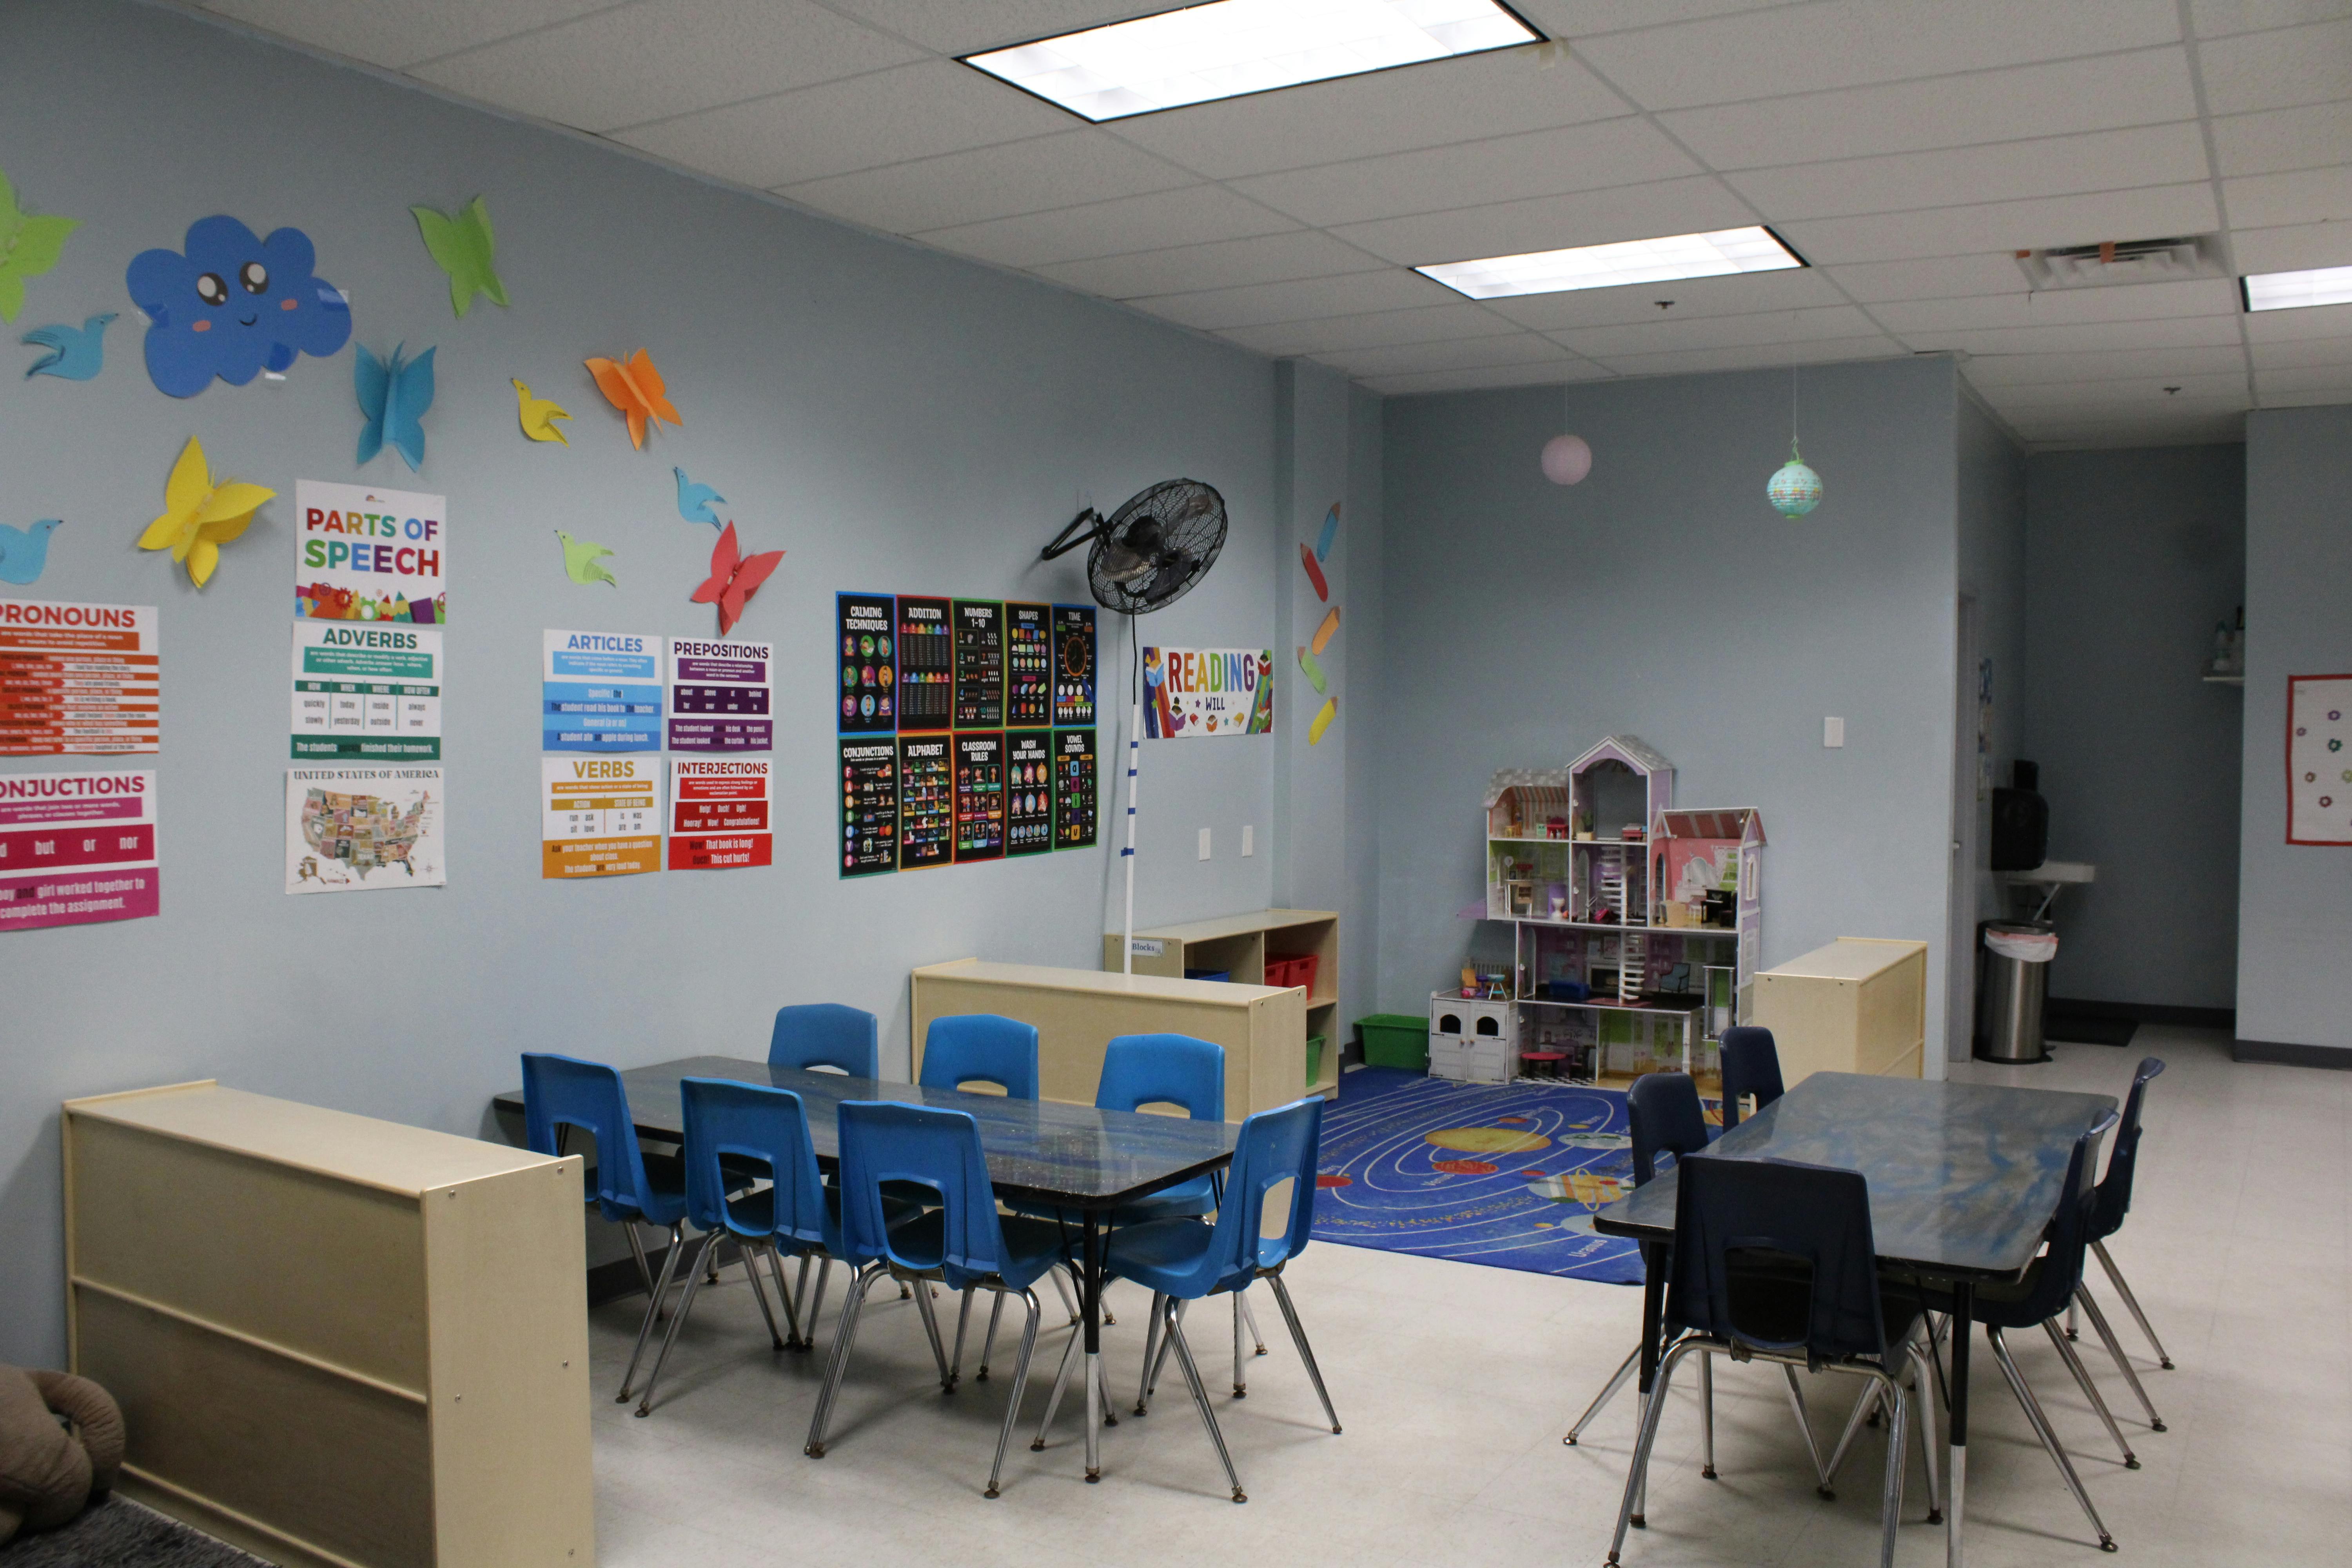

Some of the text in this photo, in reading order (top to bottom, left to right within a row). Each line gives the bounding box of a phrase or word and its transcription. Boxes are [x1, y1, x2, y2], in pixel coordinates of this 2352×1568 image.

[307, 508, 437, 541] PARTS OF
[304, 539, 439, 576] SPEECH
[0, 604, 135, 628] RONOUNS
[850, 606, 882, 618] CALMING
[908, 607, 942, 619] ADDITION
[964, 607, 992, 618] NUMBERS
[1019, 610, 1038, 621] SHAPES
[1068, 612, 1081, 621] TIME
[846, 619, 887, 631] TECHNIQUES
[972, 619, 985, 628] 1-10
[323, 628, 417, 649] ADVERBS
[568, 635, 642, 652] ARTICLES
[674, 642, 768, 659] PREPOSITIONS
[1168, 652, 1255, 692] READING
[304, 700, 325, 708] quickly
[340, 701, 354, 709] today
[408, 703, 425, 711] always
[1206, 697, 1225, 711] WILL
[305, 717, 323, 725] slowly
[334, 717, 360, 726] yesterday
[1021, 740, 1036, 749] WASH
[1067, 735, 1082, 744] VOWEL
[908, 744, 943, 757] ALPHABET
[962, 741, 996, 751] CLASSROOM
[1065, 744, 1084, 753] SOUNDS
[844, 746, 893, 758] CONJUNCTIONS
[971, 752, 988, 761] RULES
[1013, 750, 1045, 760] YOUR HANDS
[573, 761, 634, 778] VERBS
[678, 762, 768, 774] INTERJECTIONS
[846, 768, 851, 777] F
[294, 771, 334, 779] UNITED
[337, 771, 376, 779] STATES
[847, 782, 851, 792] A
[1075, 795, 1077, 806] i
[35, 840, 55, 855] but
[83, 839, 96, 851] or
[120, 837, 138, 849] nor
[706, 839, 718, 849] That
[719, 839, 733, 849] book
[733, 838, 739, 848] is
[739, 838, 753, 849] long!
[847, 841, 851, 851] Y
[711, 854, 722, 864] This
[723, 854, 733, 863] cut
[733, 853, 750, 862] hurts!
[847, 855, 852, 866] S
[37, 884, 55, 898] girl
[56, 882, 93, 895] worked
[94, 879, 133, 893] together
[135, 878, 145, 889] to
[0, 897, 125, 918] complete the assignment.
[1568, 1239, 1608, 1258] Uranus
